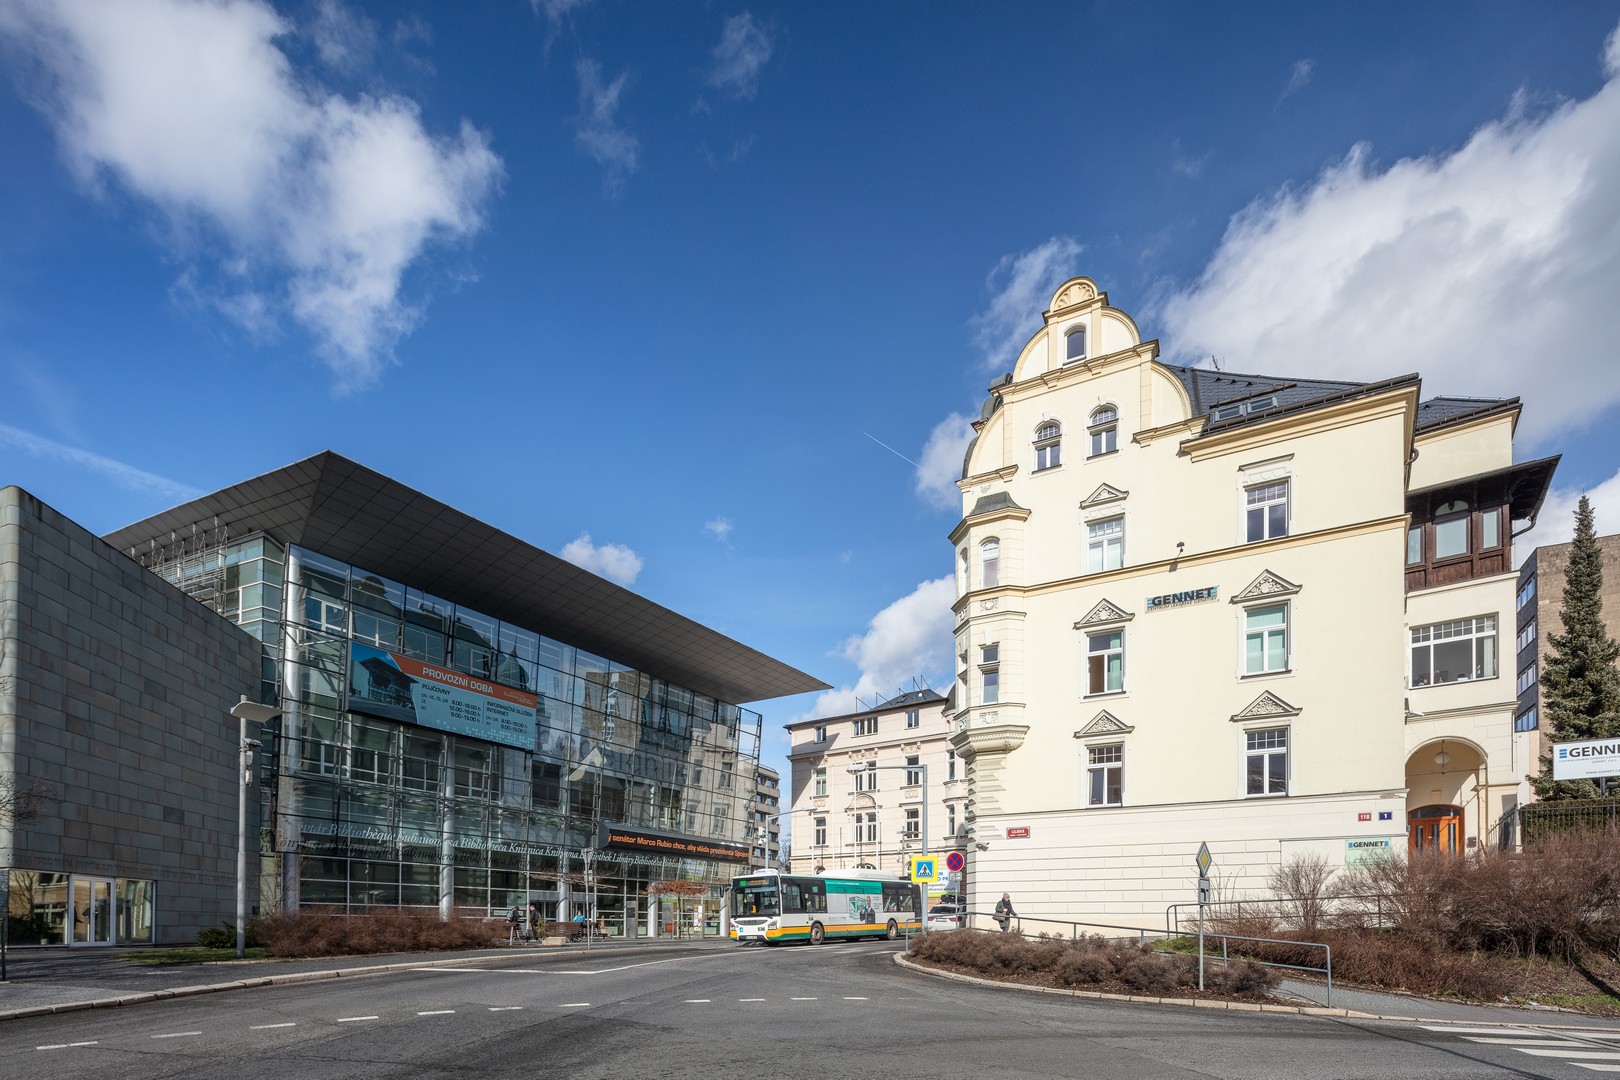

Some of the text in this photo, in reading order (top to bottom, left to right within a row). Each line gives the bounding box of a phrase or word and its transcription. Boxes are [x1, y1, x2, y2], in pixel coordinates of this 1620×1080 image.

[1152, 586, 1214, 606] GENNET
[422, 667, 493, 694] PROVOZNÍ DOBA
[329, 824, 396, 843] Bibliothèque
[397, 831, 458, 847] Библиотка
[612, 834, 636, 844] senátor
[637, 836, 656, 846] Marco
[657, 839, 672, 848] Rubio
[687, 844, 696, 853] aby
[612, 853, 634, 866] Library
